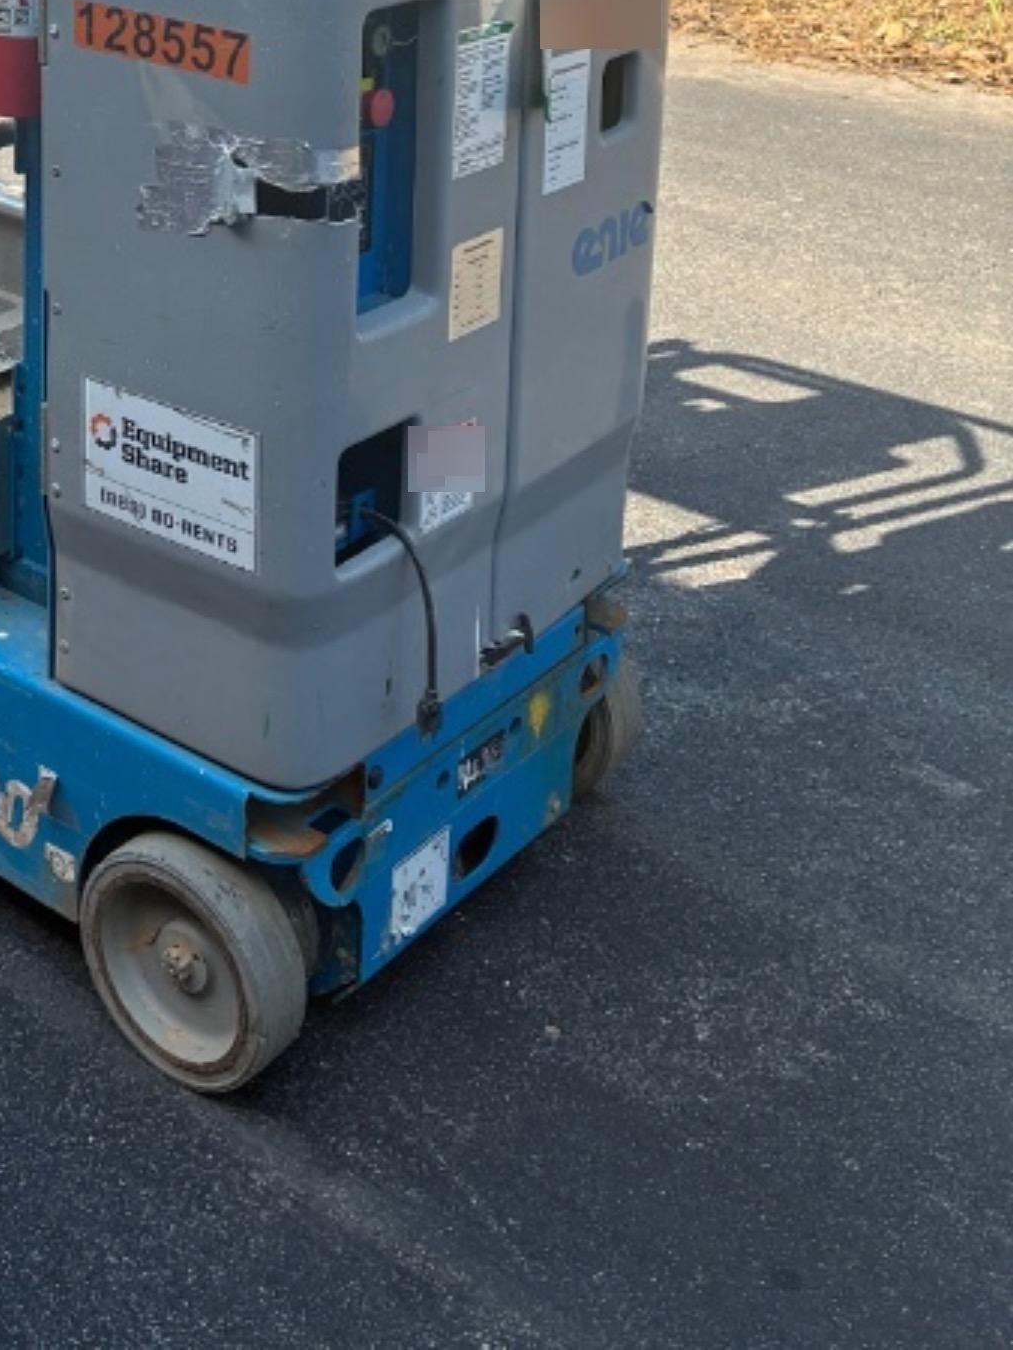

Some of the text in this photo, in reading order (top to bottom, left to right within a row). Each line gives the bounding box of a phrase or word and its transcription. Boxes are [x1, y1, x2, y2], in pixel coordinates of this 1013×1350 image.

[78, 1, 249, 78] 128557
[121, 416, 250, 481] Equipment
[121, 443, 189, 484] Share
